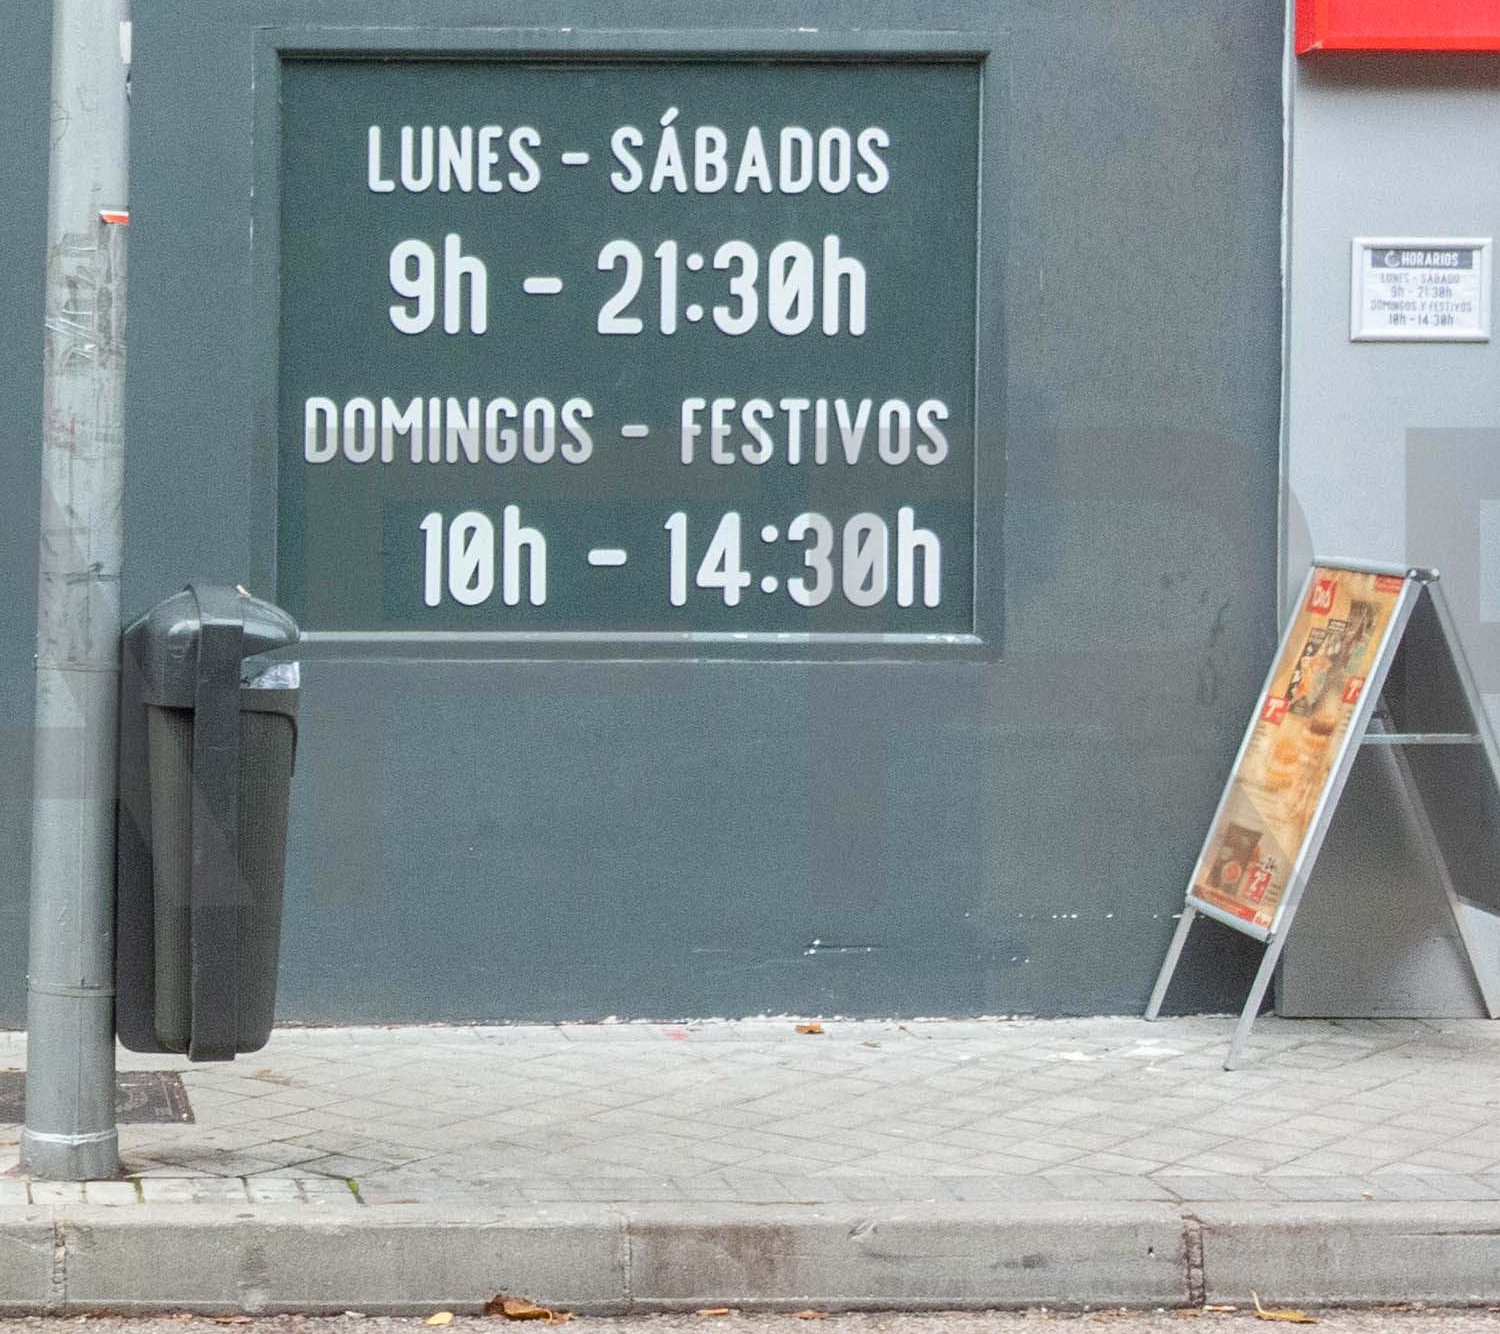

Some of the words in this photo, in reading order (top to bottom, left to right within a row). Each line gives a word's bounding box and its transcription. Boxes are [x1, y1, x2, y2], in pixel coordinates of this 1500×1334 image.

[368, 125, 542, 193] LUNES
[611, 107, 890, 194] SÁBADOS
[389, 233, 488, 335] 9h
[597, 235, 867, 336] 21:30h
[1381, 273, 1410, 284] LUNES
[1402, 252, 1458, 267] HORARIOS
[304, 397, 594, 465] DOMINGOS
[680, 397, 950, 466] FESTIVOS
[419, 505, 548, 607] 10h
[664, 506, 943, 608] 14:30h
